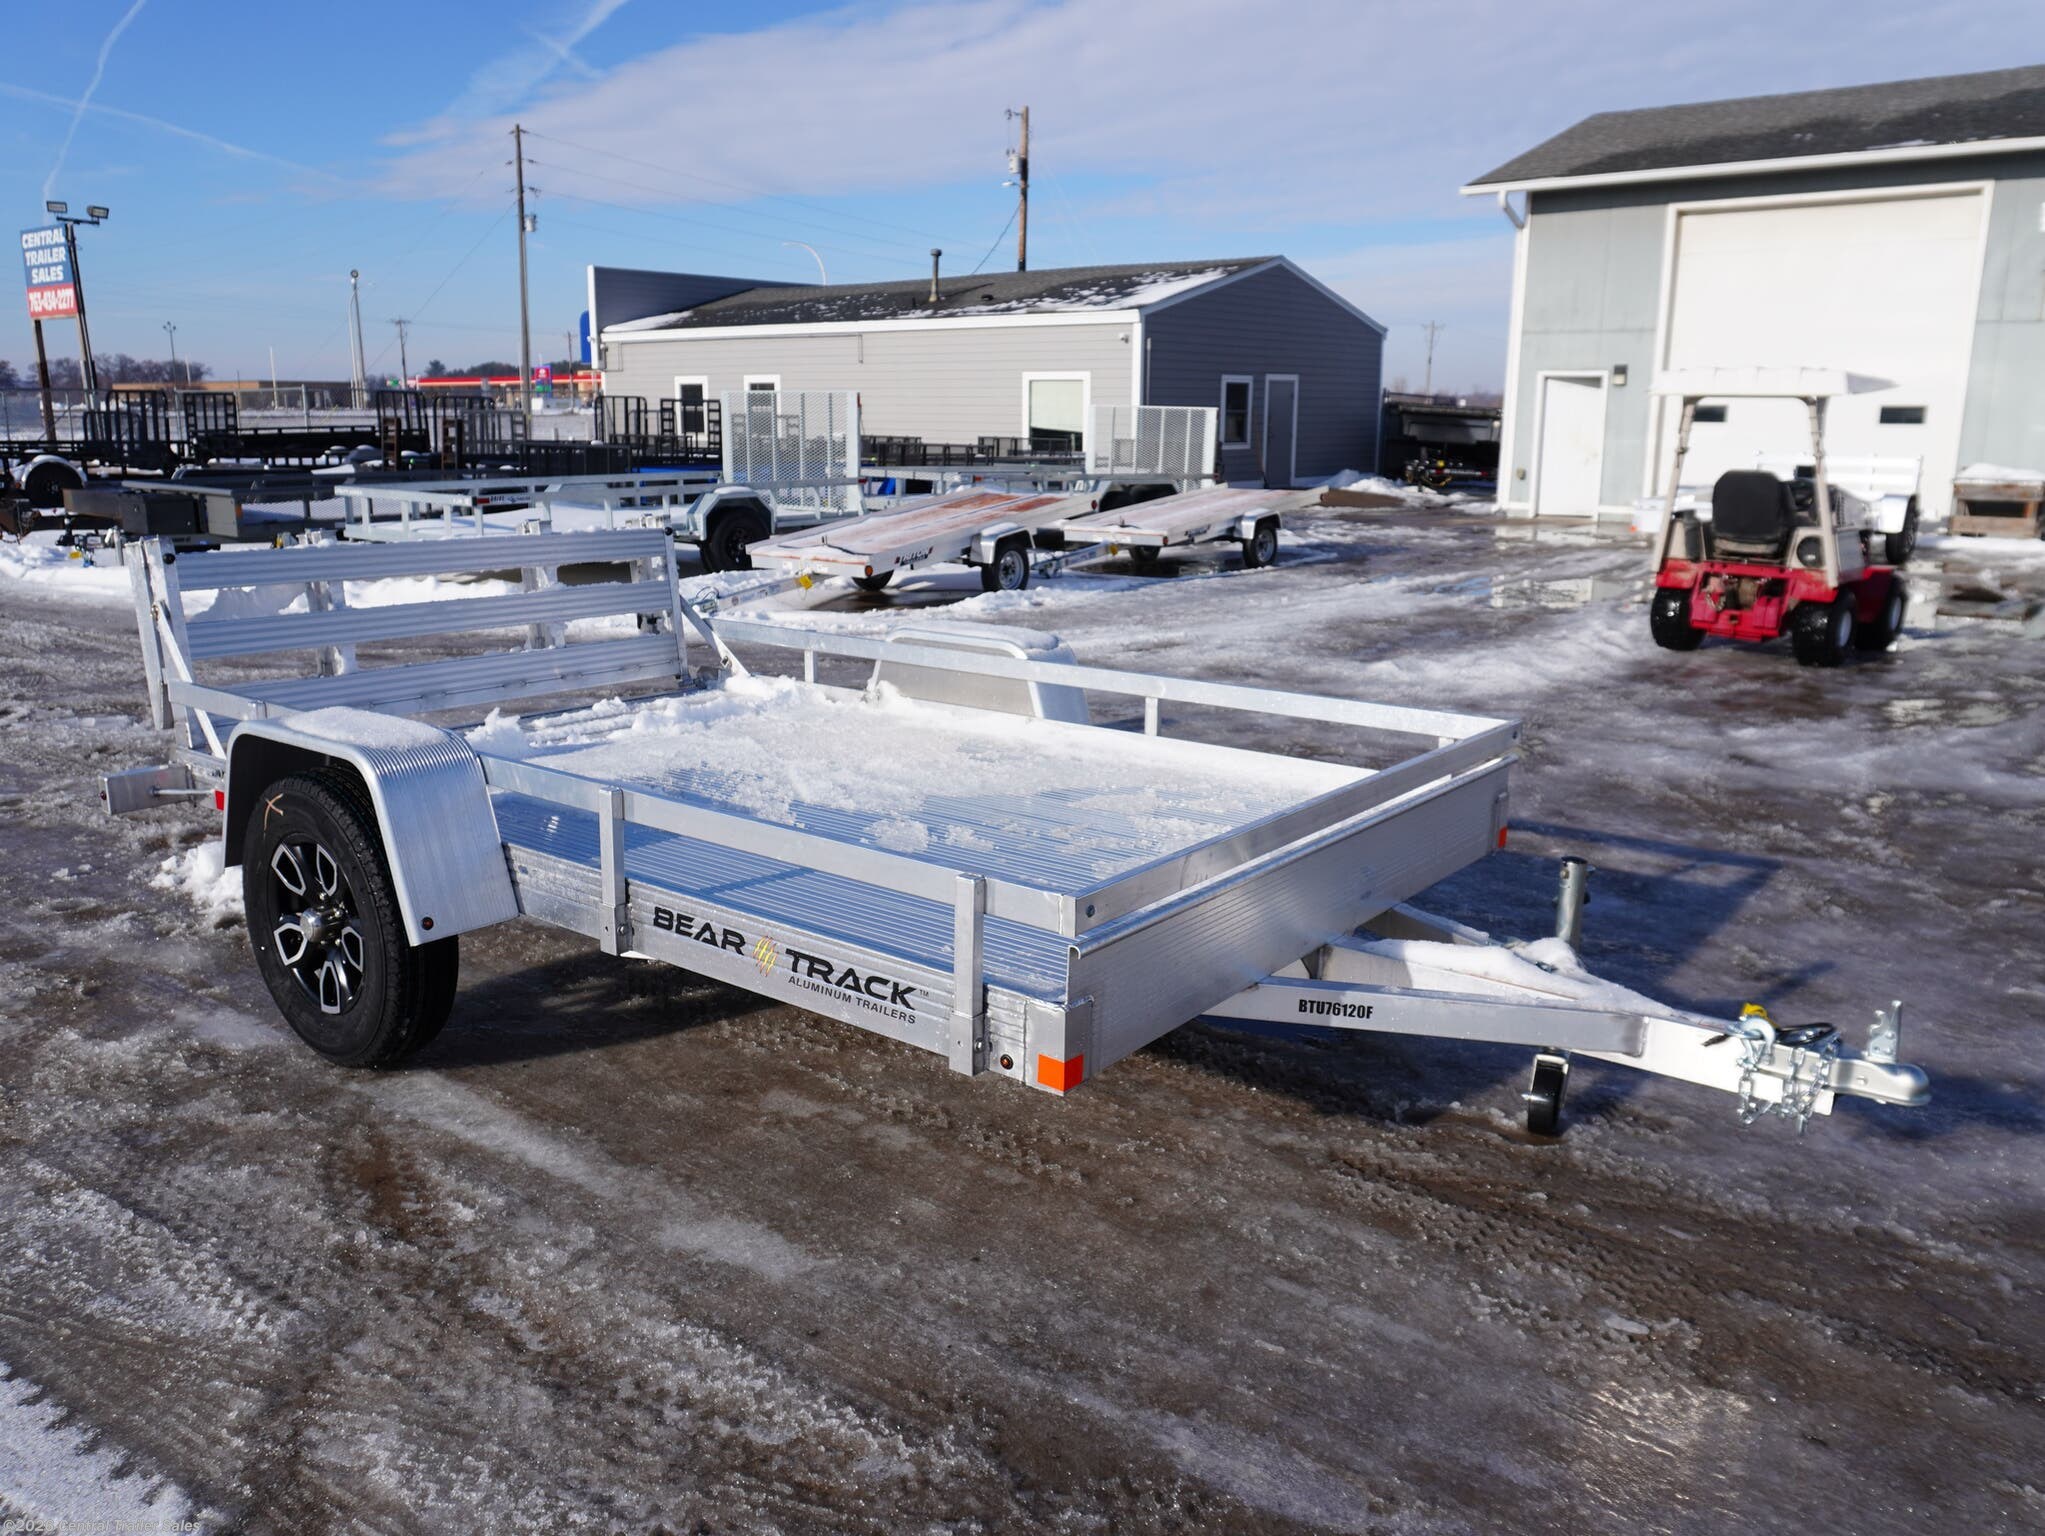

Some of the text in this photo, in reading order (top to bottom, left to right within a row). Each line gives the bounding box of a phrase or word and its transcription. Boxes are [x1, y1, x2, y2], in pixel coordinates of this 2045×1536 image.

[22, 228, 65, 249] CENTRAL
[25, 246, 66, 266] TRAILER
[31, 265, 64, 284] SALES
[653, 906, 746, 956] BEAR
[785, 948, 917, 1011] TRACK
[788, 976, 916, 1025] ALUMINUM TRAILERS
[1298, 999, 1374, 1019] BTU76120F
